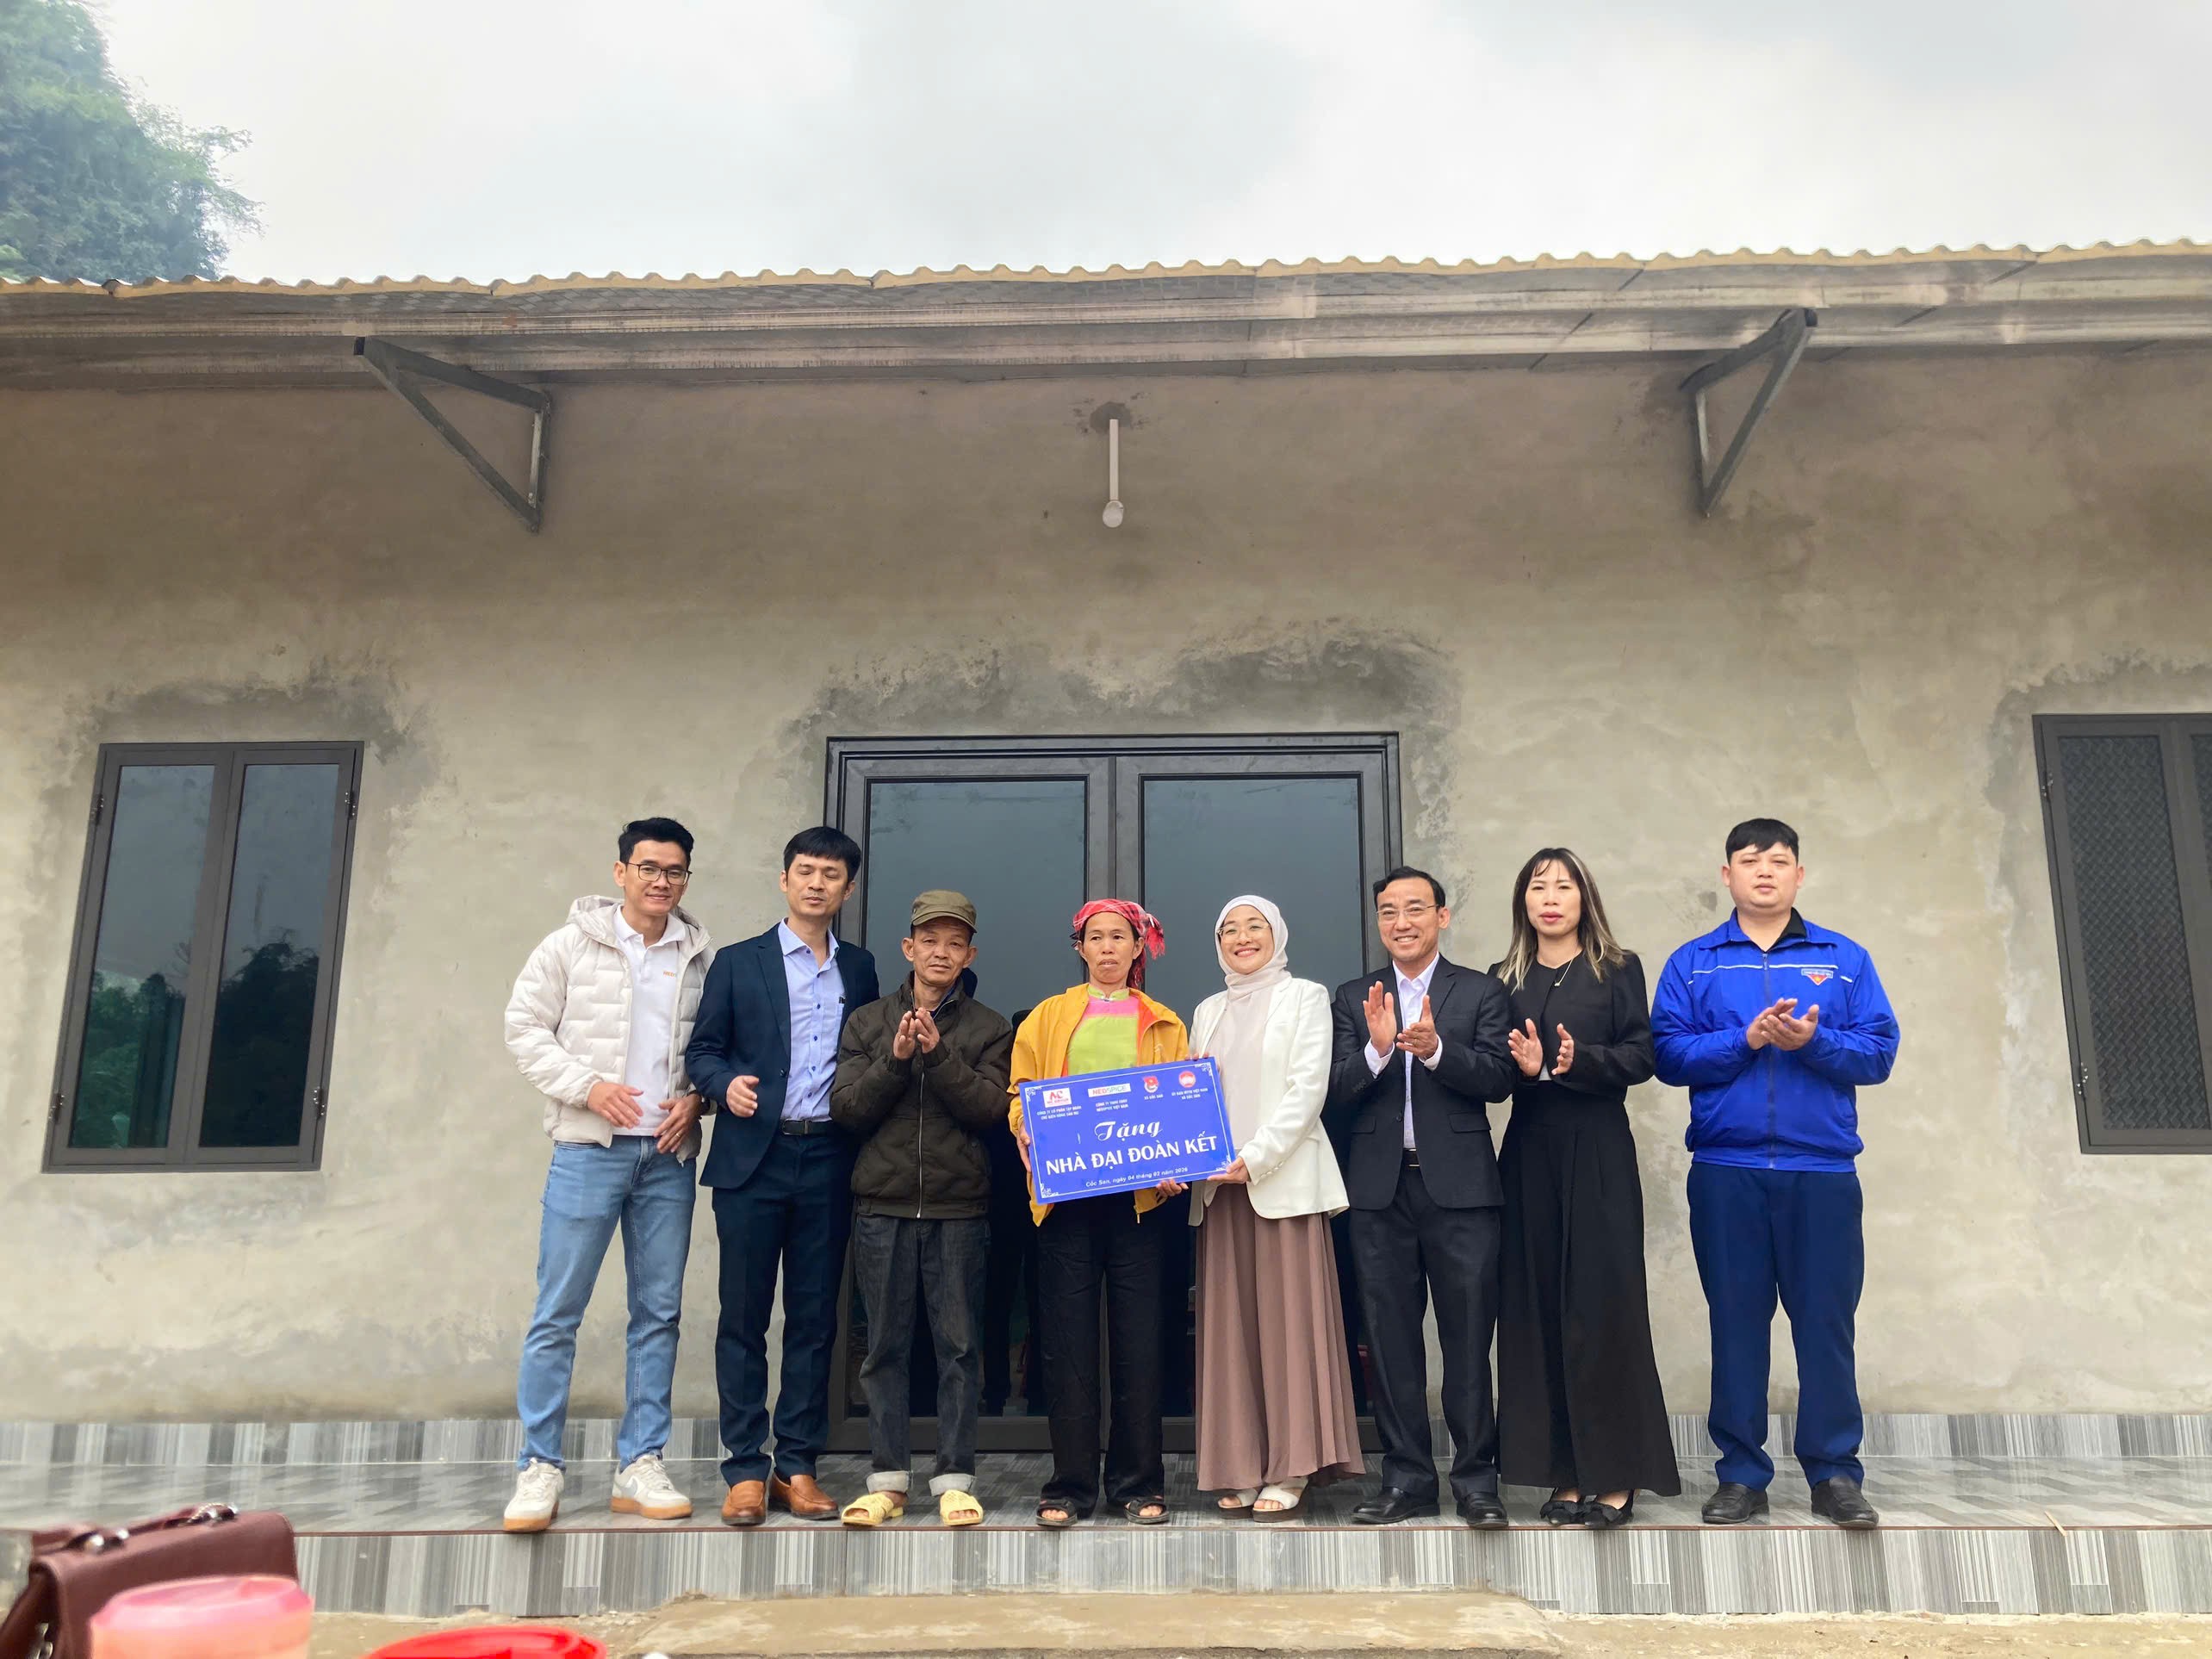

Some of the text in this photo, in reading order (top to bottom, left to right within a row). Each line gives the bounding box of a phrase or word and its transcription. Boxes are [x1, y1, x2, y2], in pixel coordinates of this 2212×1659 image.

[1092, 1085, 1126, 1095] NEDSPICE
[1094, 1121, 1163, 1141] Tặng
[1046, 1130, 1218, 1175] NHÀ ĐẠI ĐOÀN KẾT
